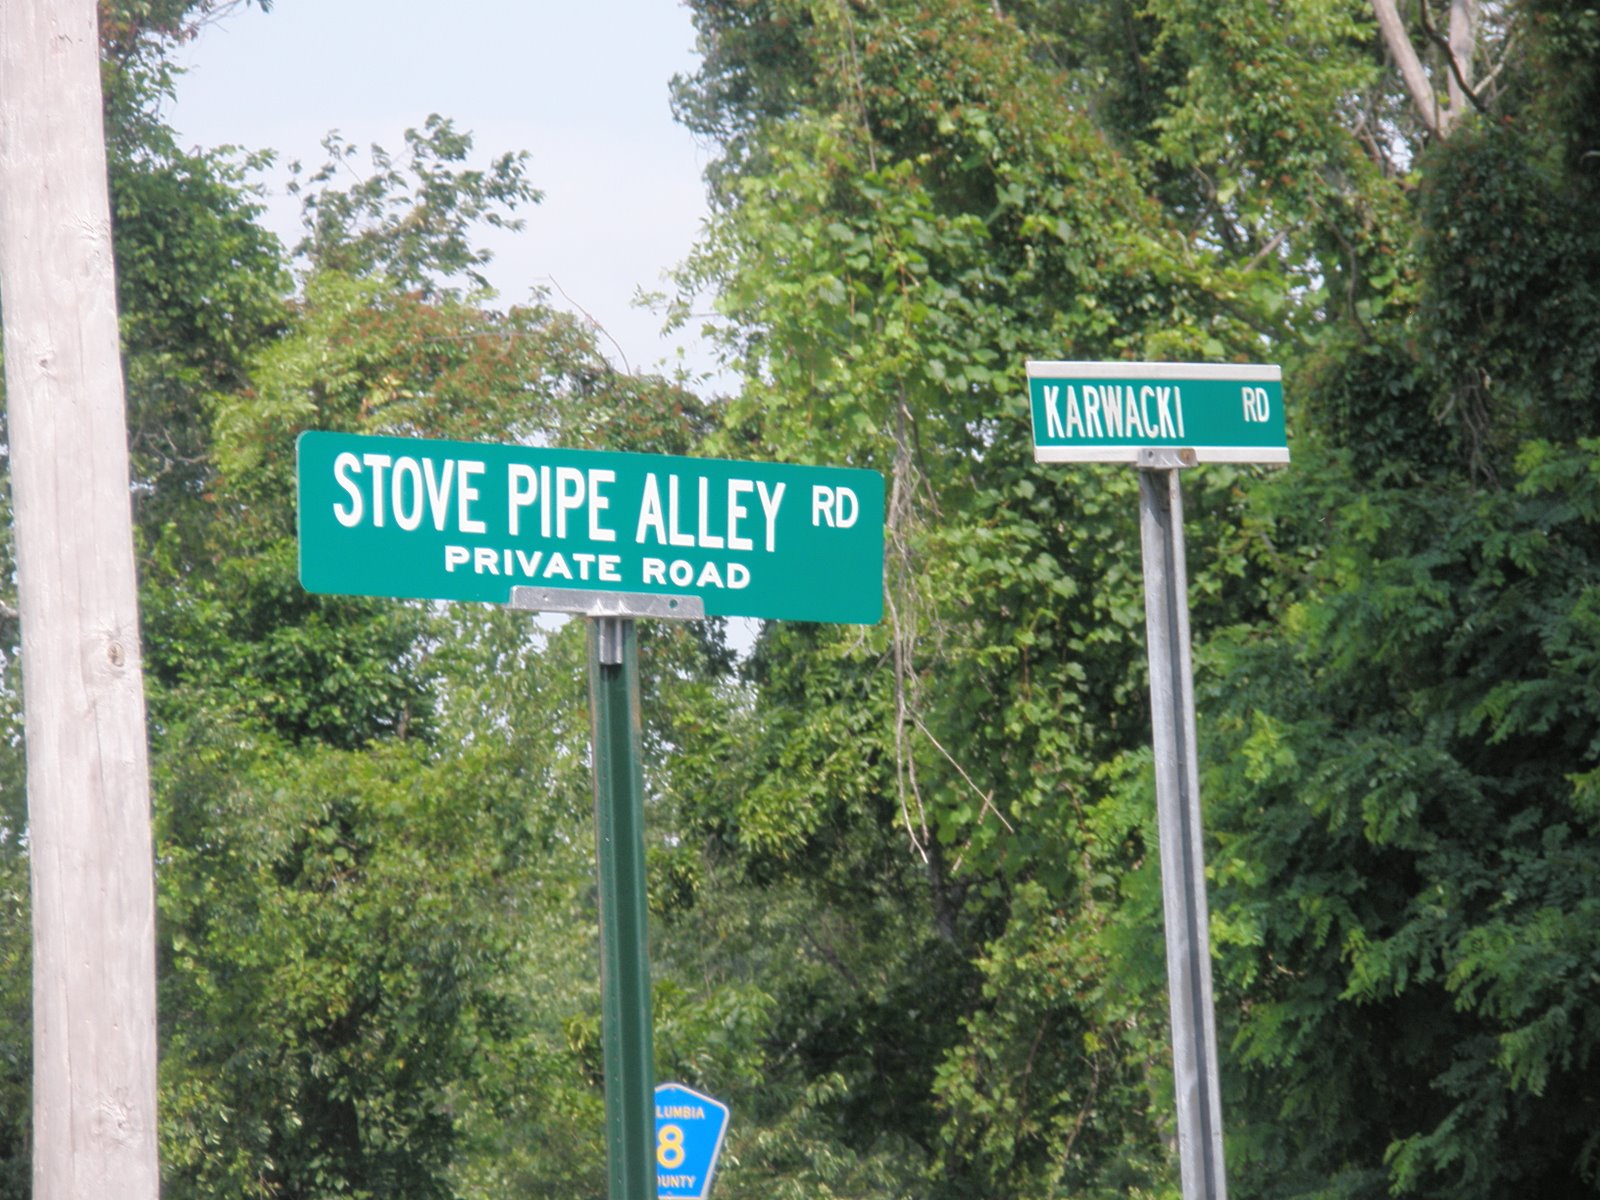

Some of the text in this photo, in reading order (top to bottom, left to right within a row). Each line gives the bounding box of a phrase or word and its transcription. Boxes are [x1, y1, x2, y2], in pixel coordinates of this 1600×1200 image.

[1044, 385, 1270, 439] KARWACKI RD
[333, 452, 859, 554] STOVE PIPE ALLEY RD
[445, 545, 751, 590] PRIVATE ROAD
[655, 1106, 705, 1119] LUMBIA
[656, 1125, 685, 1169] 8
[657, 1175, 695, 1188] UNTY
